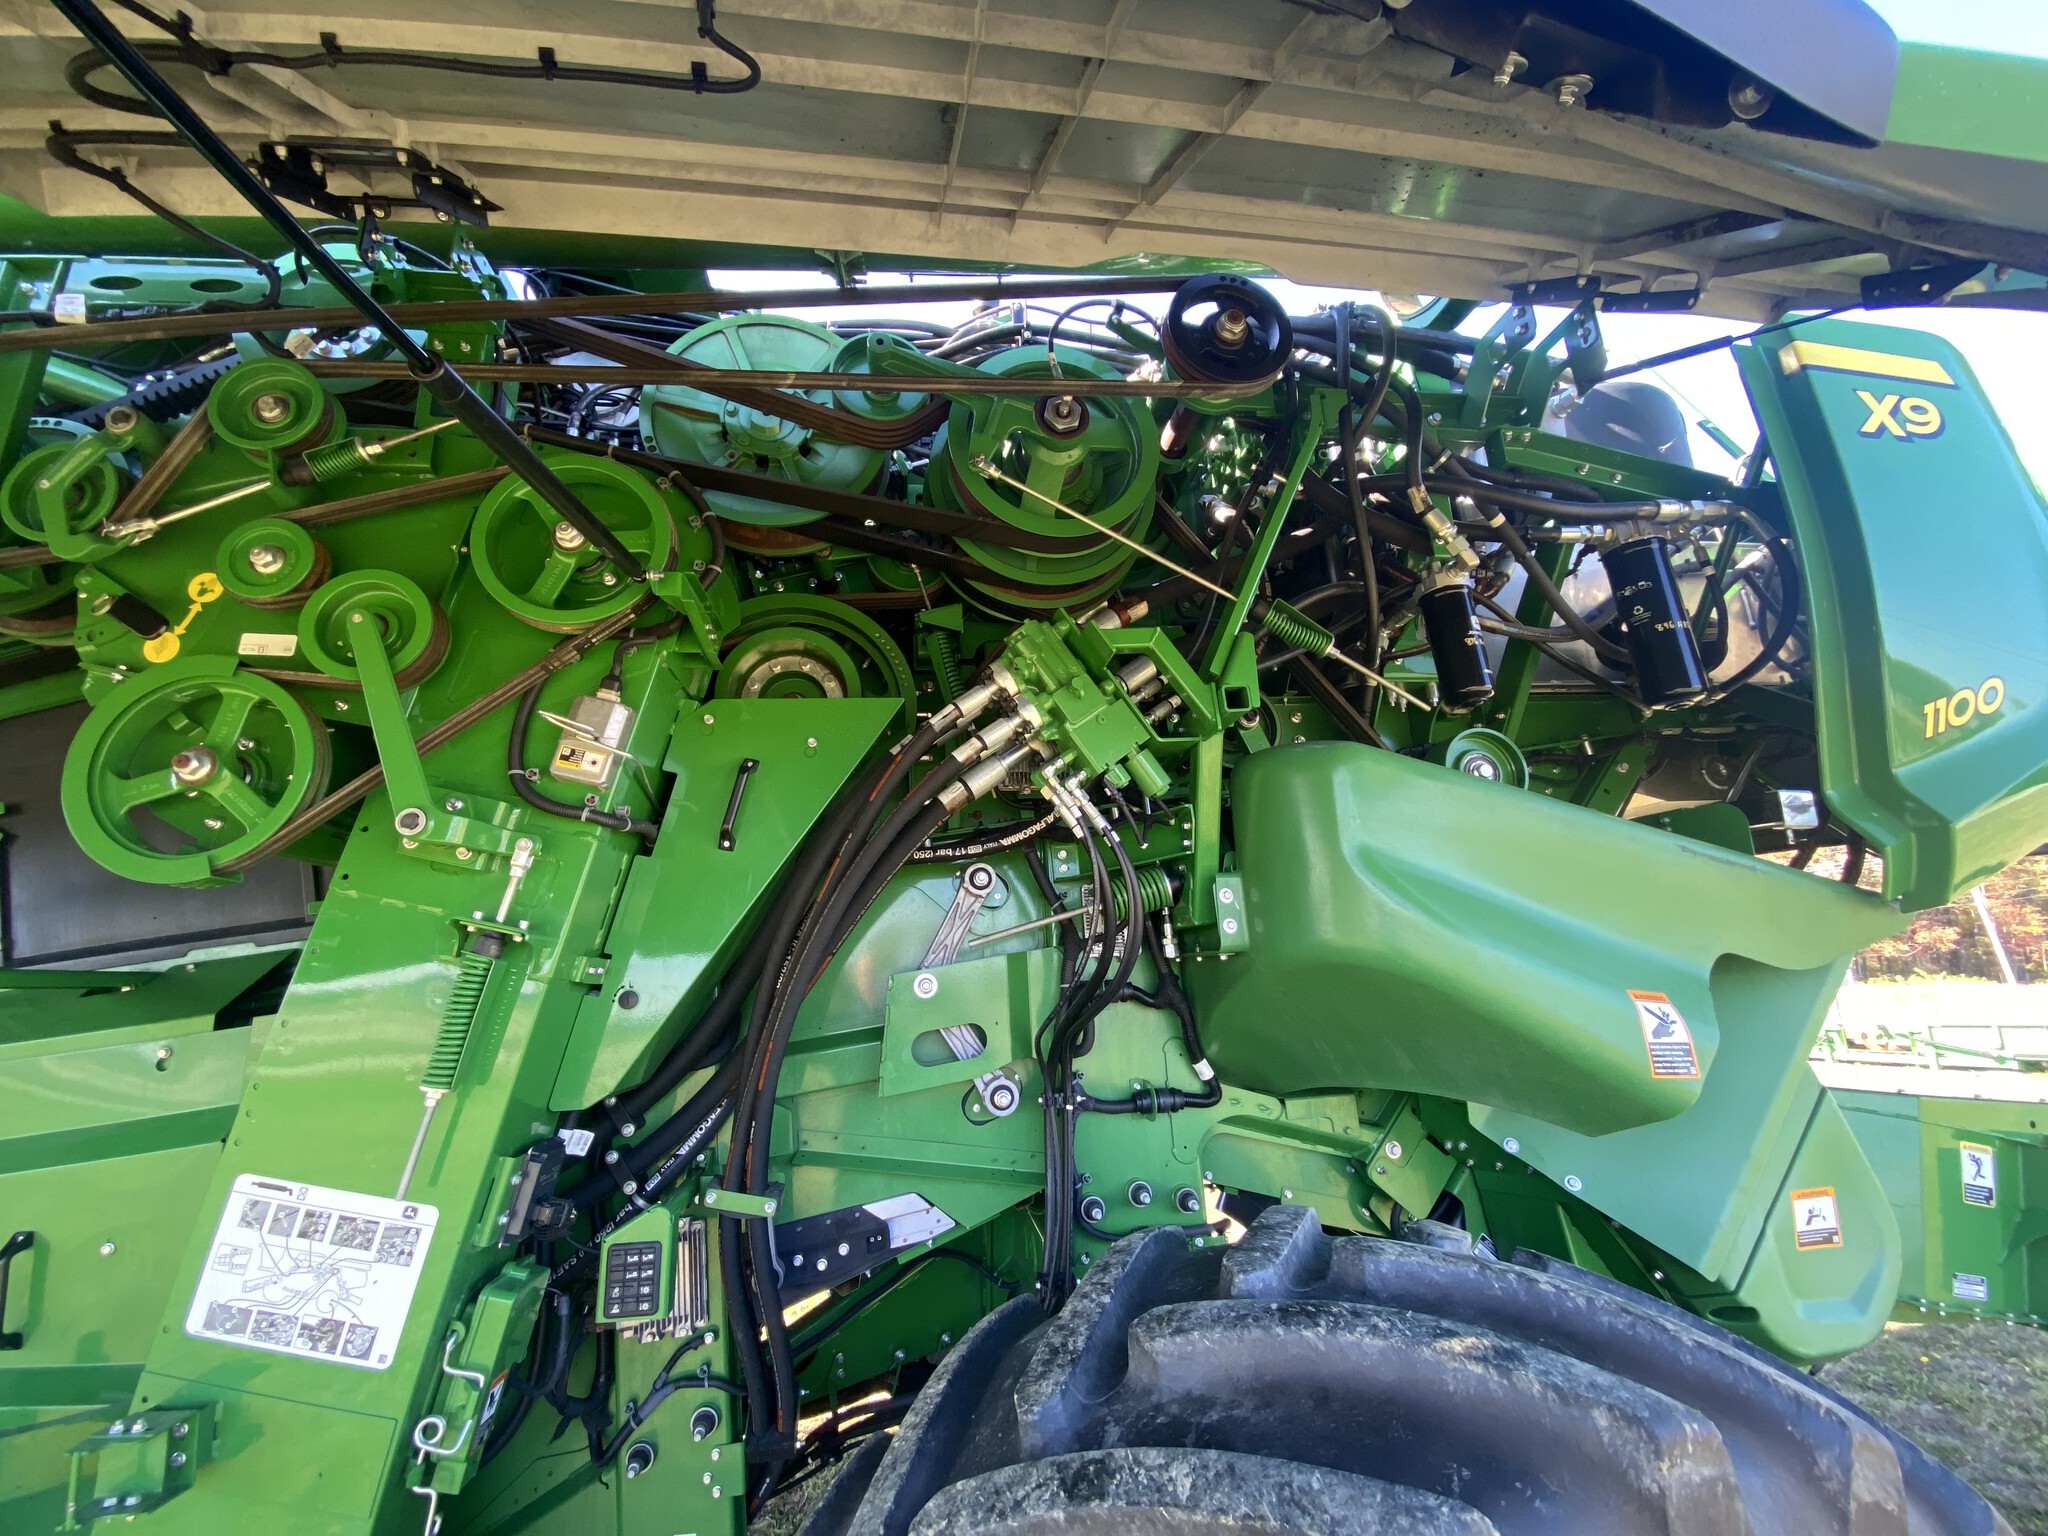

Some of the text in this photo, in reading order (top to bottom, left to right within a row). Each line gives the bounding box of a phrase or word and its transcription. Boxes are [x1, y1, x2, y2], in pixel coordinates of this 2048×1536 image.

[1852, 388, 1945, 441] X9
[1923, 676, 2005, 740] 1100
[999, 812, 1054, 846] ALFAGOMMA
[935, 847, 953, 857] bar
[660, 1158, 675, 1174] ITALY
[615, 1204, 634, 1222] bar
